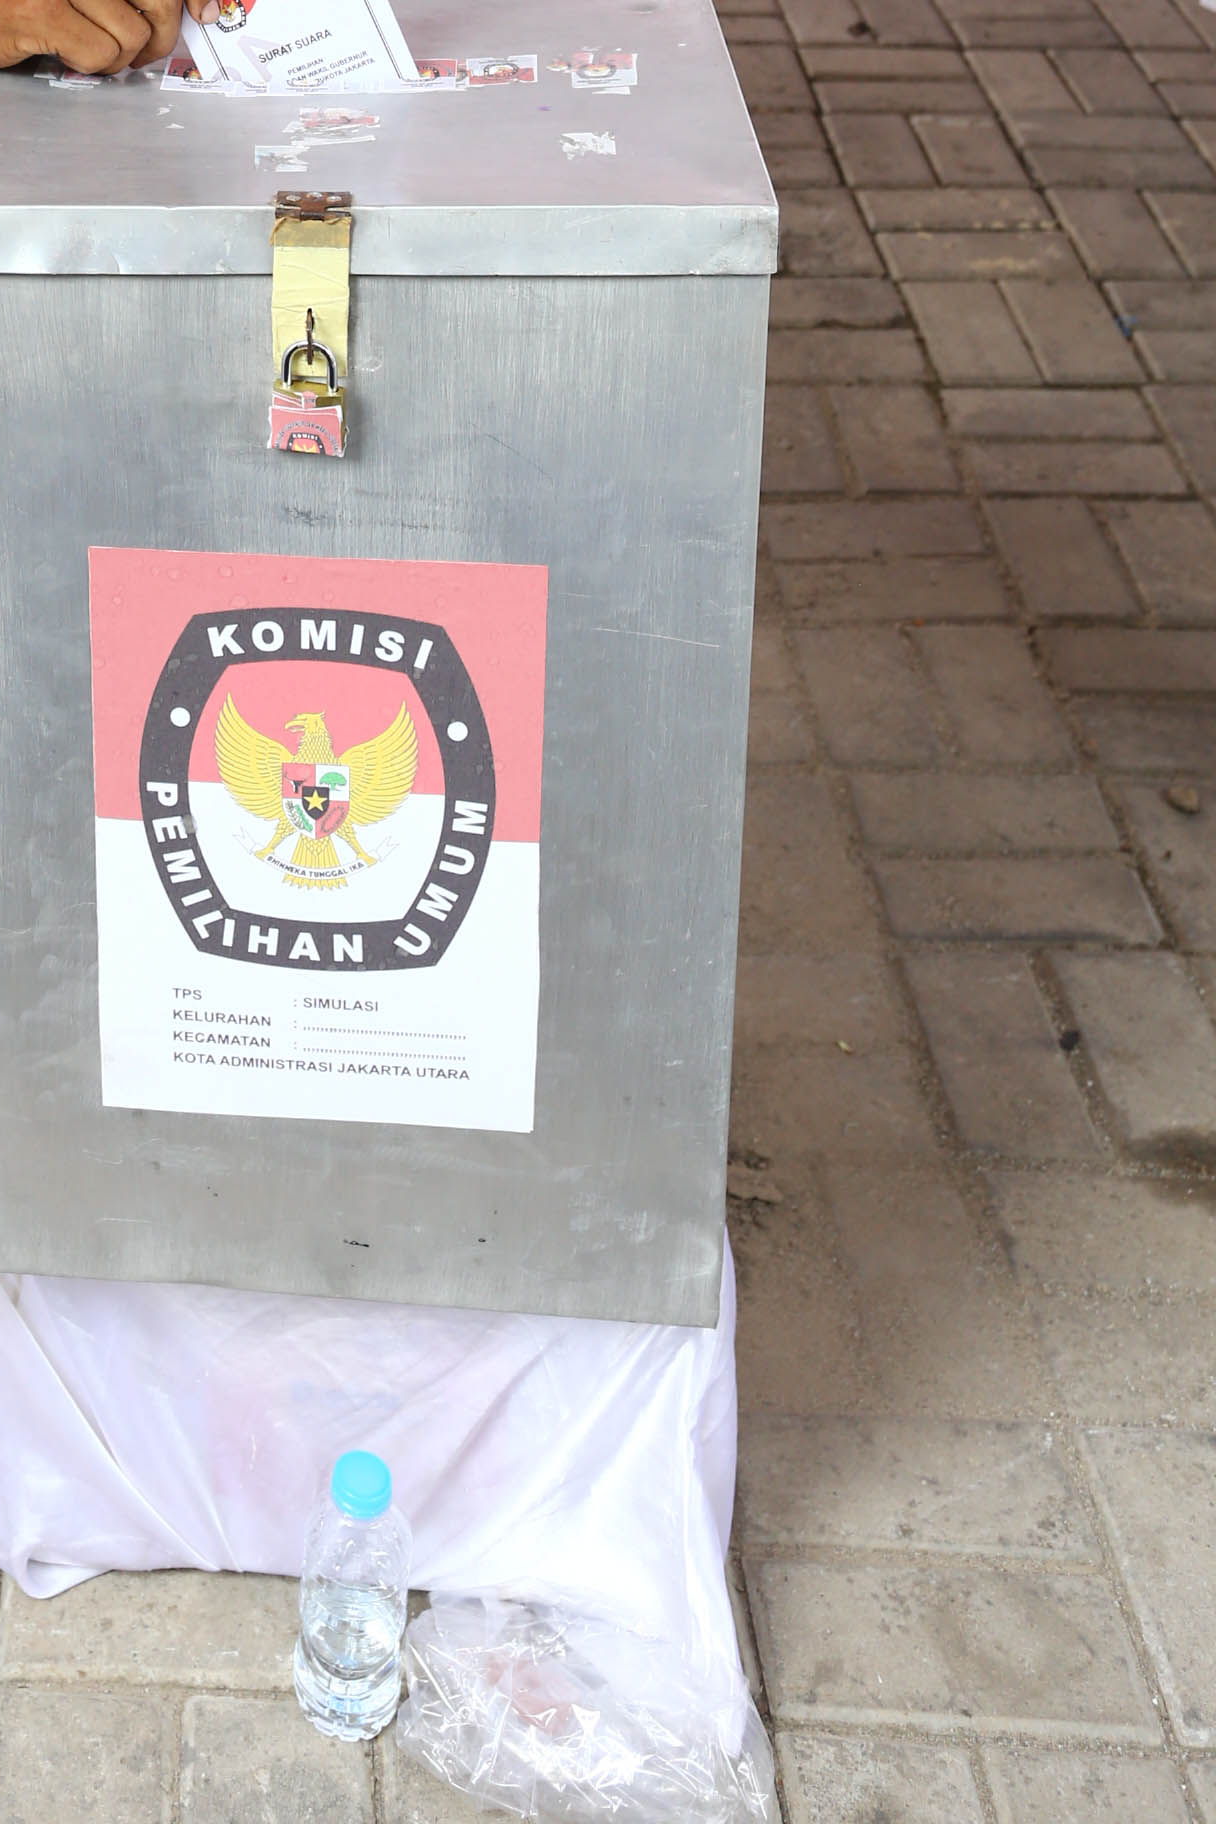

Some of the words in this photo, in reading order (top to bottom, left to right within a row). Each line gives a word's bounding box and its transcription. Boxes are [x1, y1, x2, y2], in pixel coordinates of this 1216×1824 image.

[258, 43, 293, 64] SURAT
[294, 28, 333, 50] SUARA
[329, 49, 368, 70] GUBERNUR
[344, 57, 377, 74] JAKARTA
[207, 619, 435, 670] KOMISI
[146, 780, 364, 963] PEMILIHAN
[266, 855, 307, 877] BHINNEKA
[308, 868, 348, 878] TUNGGAL
[349, 861, 365, 873] IKA
[393, 799, 489, 956] UMUM
[172, 987, 203, 1001] TPS
[302, 997, 380, 1012] SIMULASI
[172, 1009, 272, 1027] KELURAHAN
[172, 1030, 272, 1048] KECAMATAN
[173, 1051, 216, 1066] KOTA
[220, 1055, 333, 1073] ADMINISTRASI
[337, 1062, 412, 1077] JAKARTA
[416, 1066, 471, 1081] UTARA
